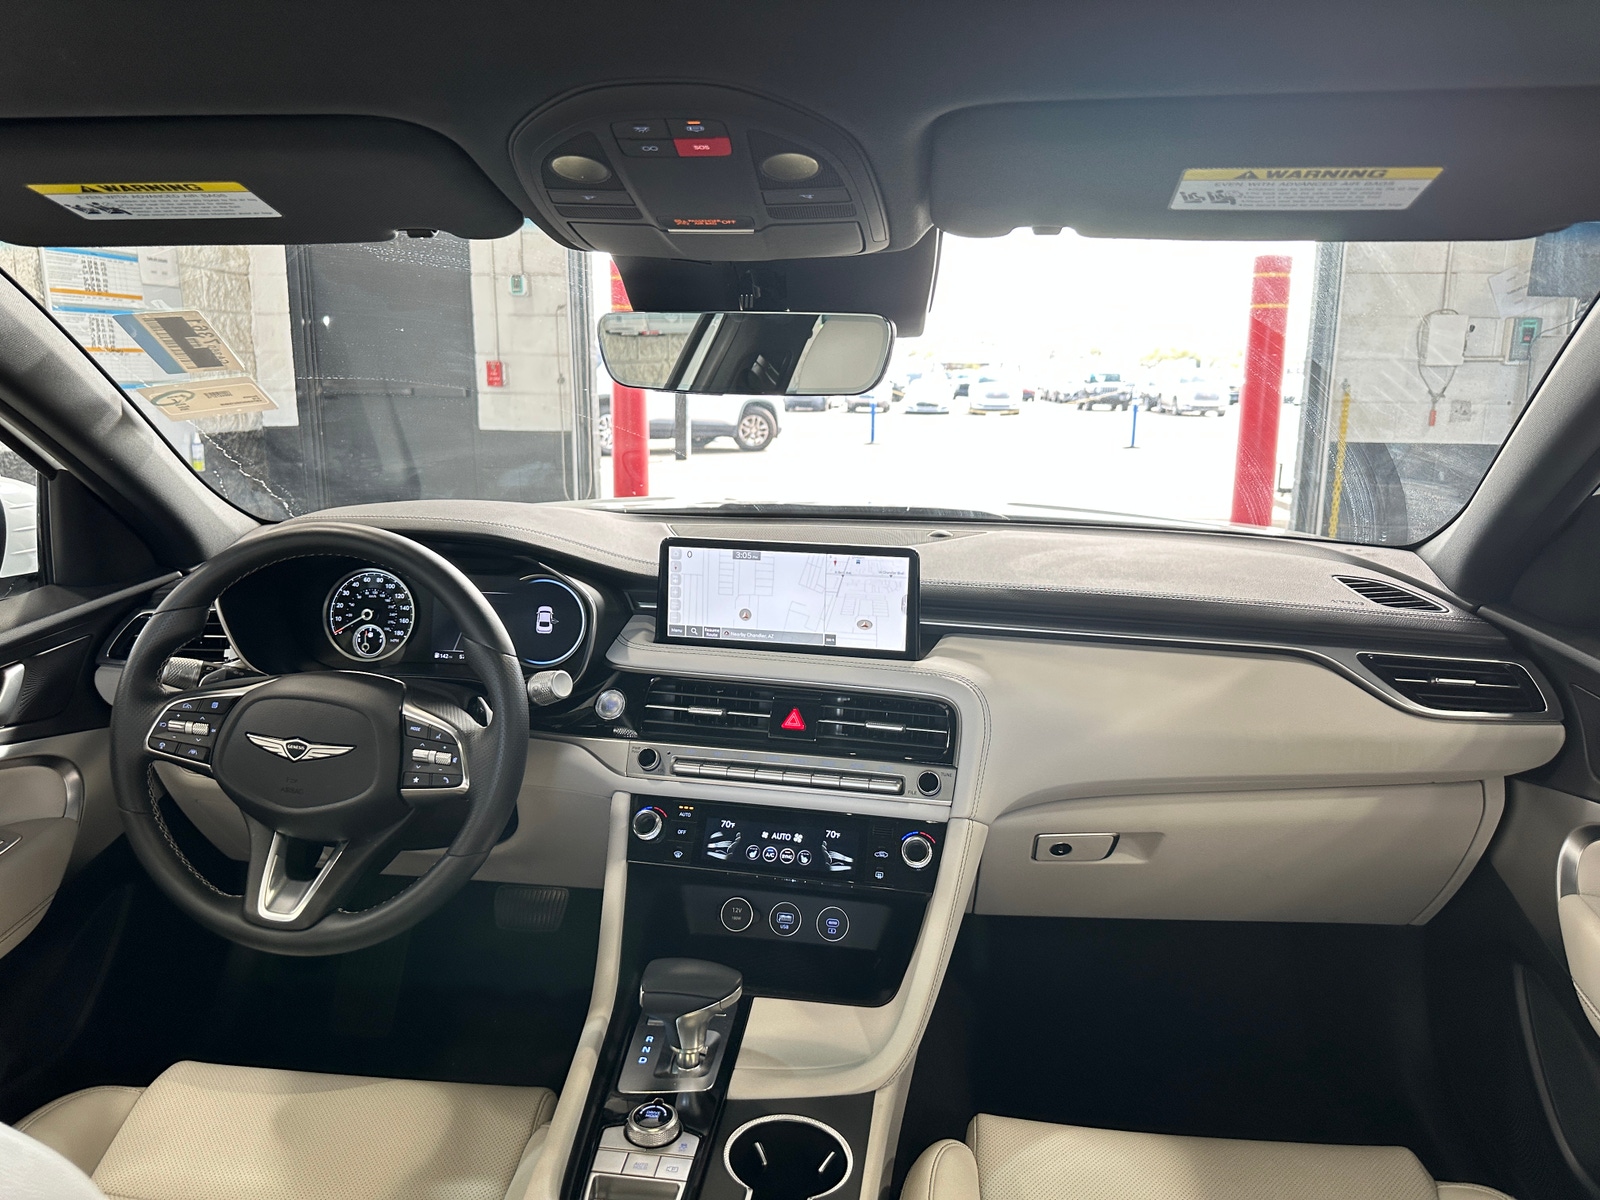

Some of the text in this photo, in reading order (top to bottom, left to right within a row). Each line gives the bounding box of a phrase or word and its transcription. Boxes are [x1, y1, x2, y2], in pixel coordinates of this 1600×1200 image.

[1266, 169, 1389, 180] WARNING
[97, 182, 204, 193] WARNING
[736, 551, 752, 559] 3:05
[771, 832, 792, 841] AUTO
[645, 1035, 654, 1043] R
[638, 1056, 648, 1064] D
